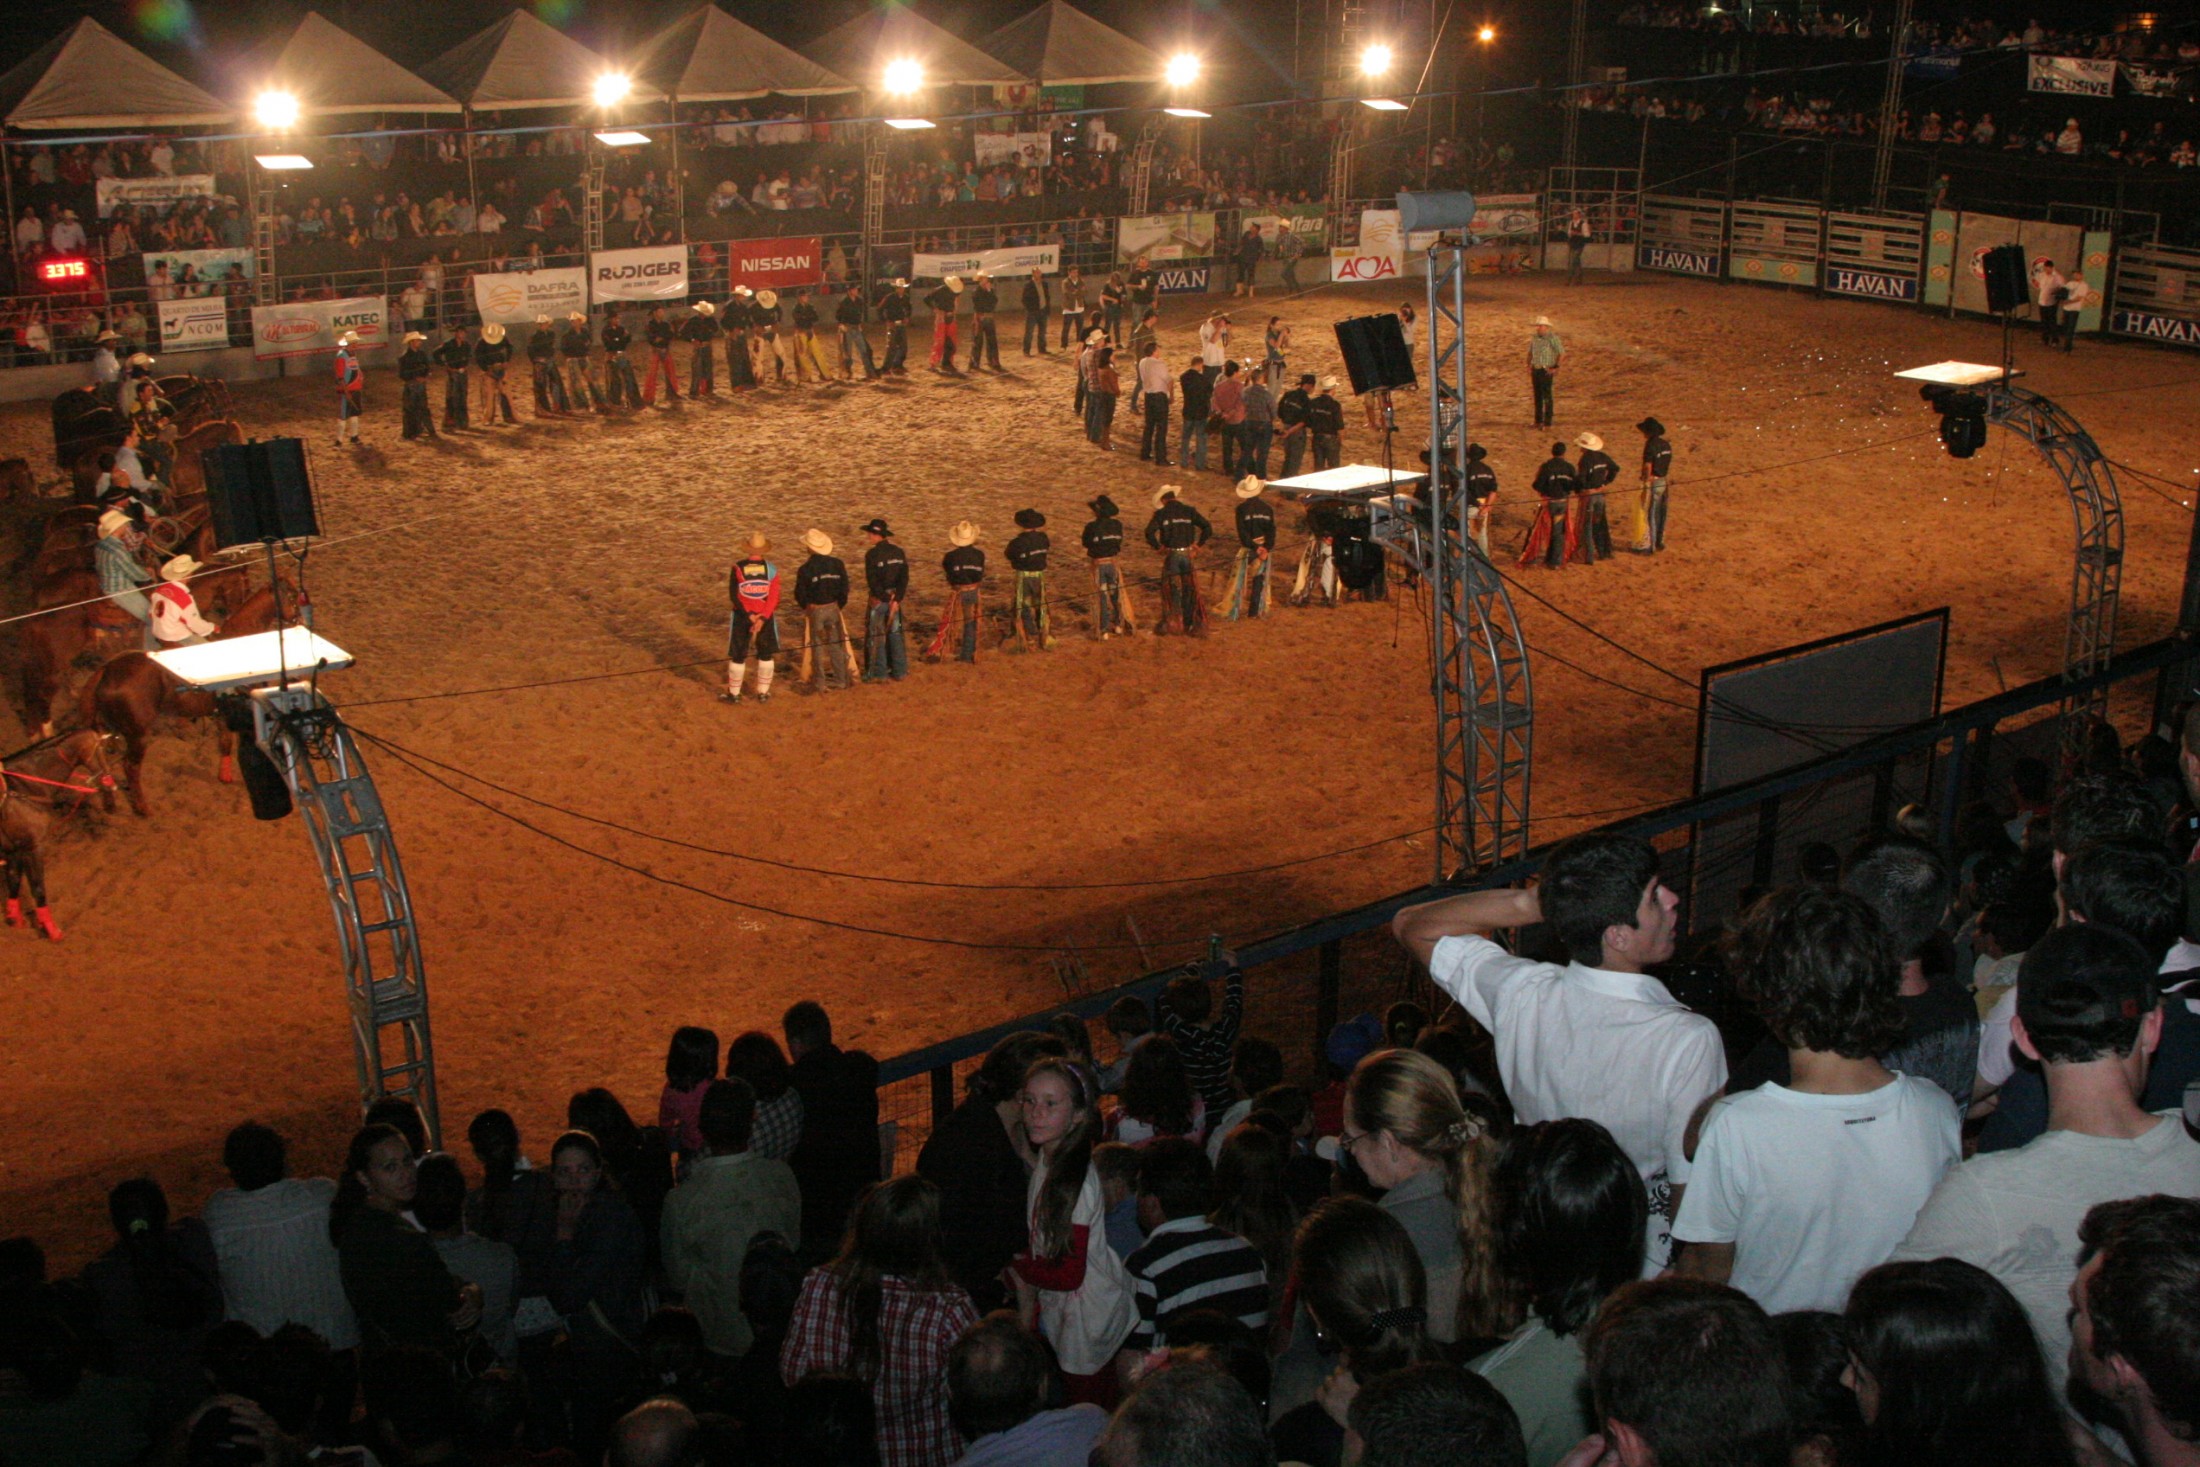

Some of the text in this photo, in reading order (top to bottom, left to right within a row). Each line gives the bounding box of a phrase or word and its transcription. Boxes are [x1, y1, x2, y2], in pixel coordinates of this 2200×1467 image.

[2032, 77, 2110, 95] EXCLUSIVE
[1290, 215, 1324, 233] Stara
[741, 255, 810, 272] NISSAN
[1650, 250, 1710, 274] HAVAN
[527, 281, 580, 294] DAFRA
[1158, 269, 1207, 289] AVAN
[1837, 271, 1905, 297] HAVAN
[333, 312, 380, 327] KATEC
